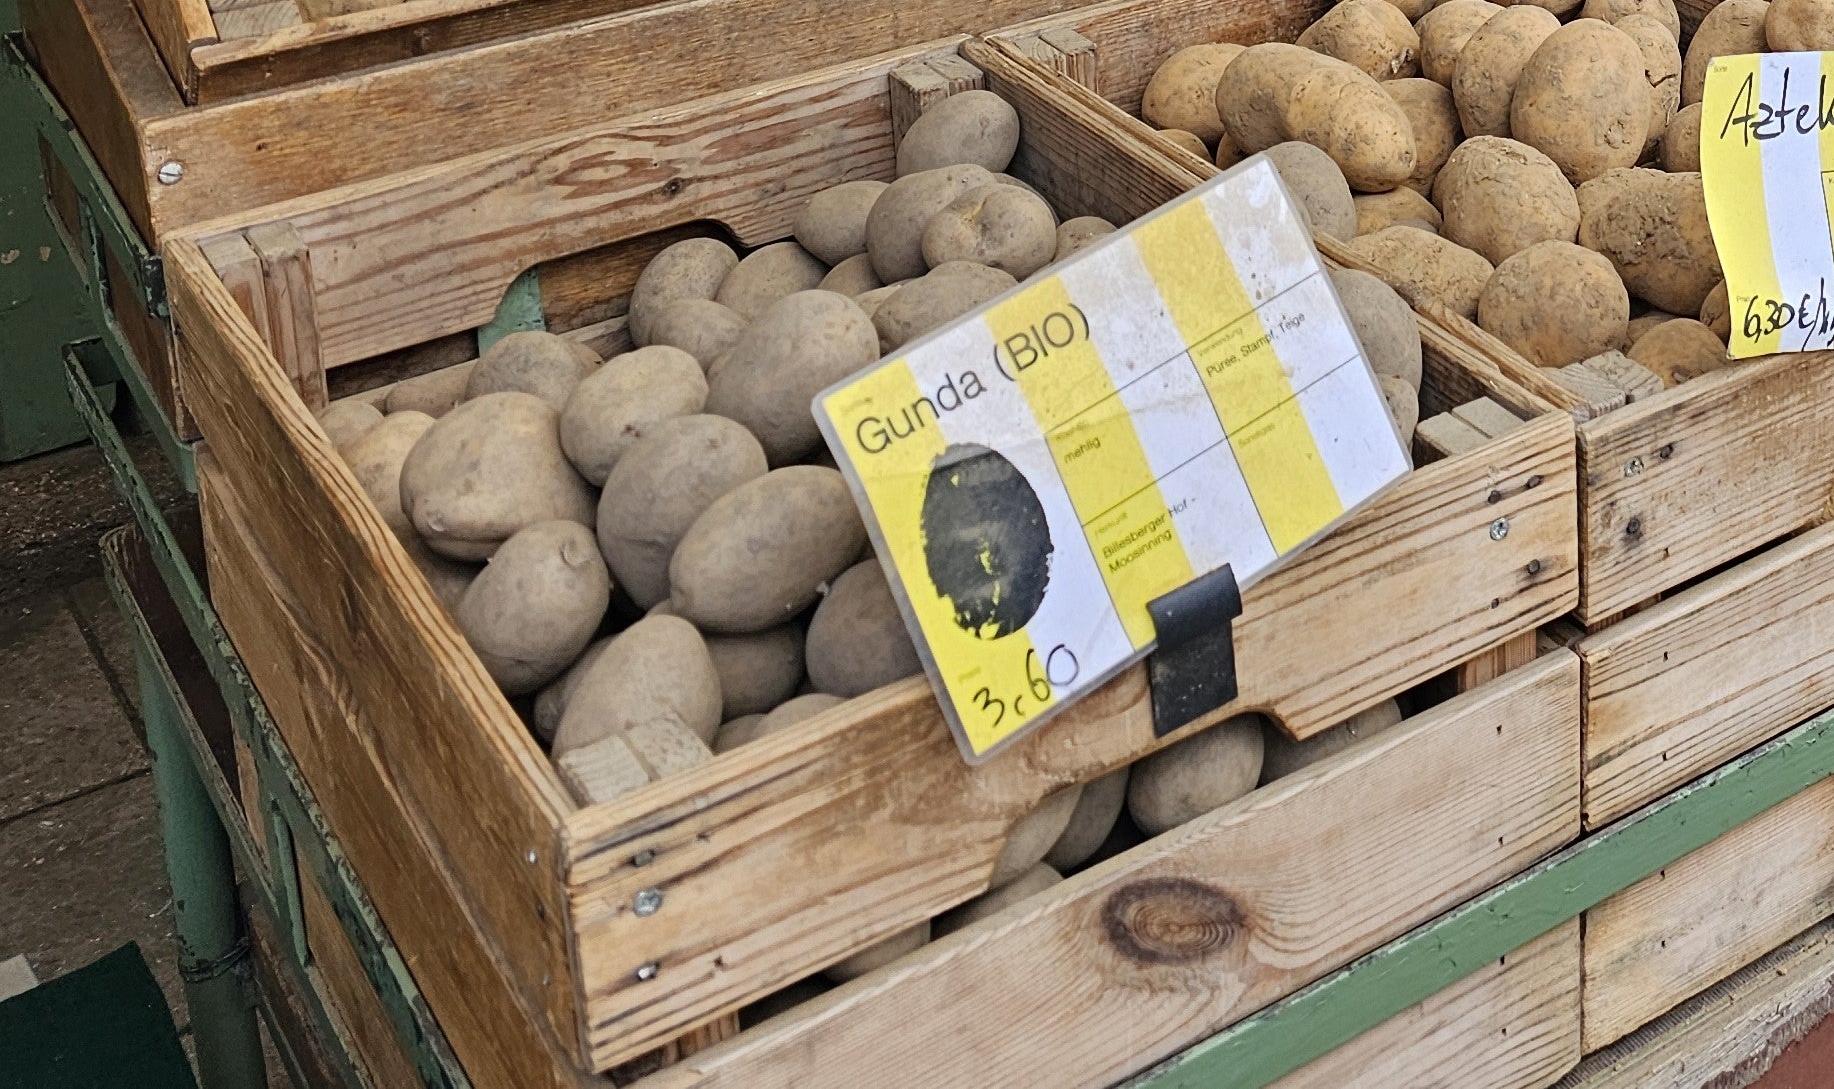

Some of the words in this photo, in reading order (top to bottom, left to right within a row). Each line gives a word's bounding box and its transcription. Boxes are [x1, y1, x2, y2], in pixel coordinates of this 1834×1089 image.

[1205, 351, 1240, 377] Püree,
[1239, 328, 1278, 357] Stampf,
[1278, 311, 1306, 333] Teige
[856, 367, 984, 456] Gunda
[994, 302, 1091, 383] (BIO)
[1063, 435, 1100, 464] mehlig
[1102, 513, 1167, 558] Billesberger
[1167, 500, 1188, 517] Hof
[1108, 528, 1172, 574] Moosinning
